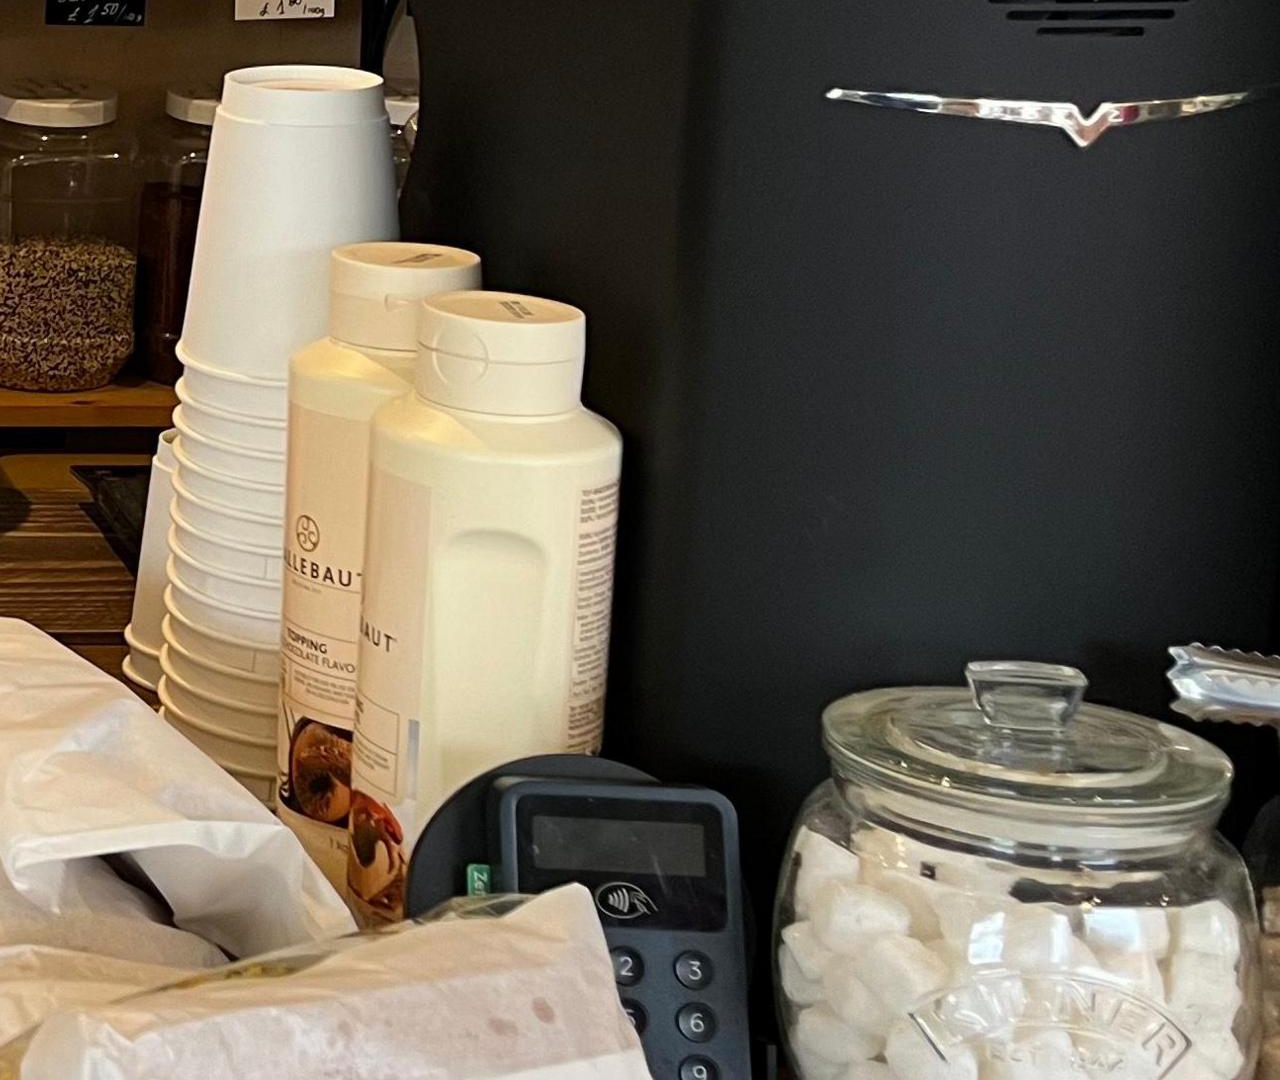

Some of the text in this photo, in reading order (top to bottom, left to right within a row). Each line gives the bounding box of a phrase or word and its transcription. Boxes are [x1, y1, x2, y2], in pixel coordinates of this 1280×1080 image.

[284, 550, 363, 588] LLEBAU
[321, 656, 356, 674] FLAVO
[619, 956, 703, 981] 2 3
[690, 1012, 705, 1033] 6
